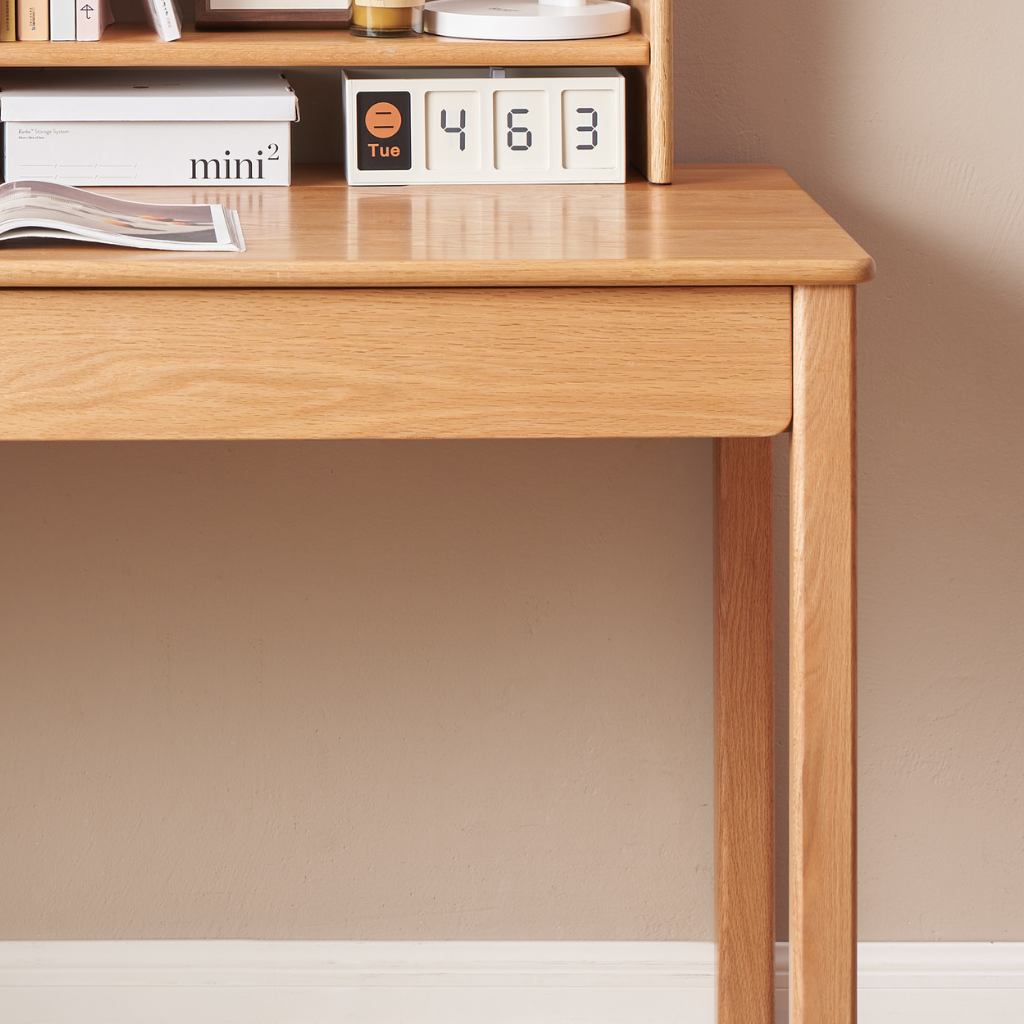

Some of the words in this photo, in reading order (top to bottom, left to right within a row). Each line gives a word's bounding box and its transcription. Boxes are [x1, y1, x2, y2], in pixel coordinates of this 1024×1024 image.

[440, 108, 466, 152] 4
[507, 108, 532, 151] 6
[576, 107, 598, 151] 3
[367, 143, 401, 158] Tue
